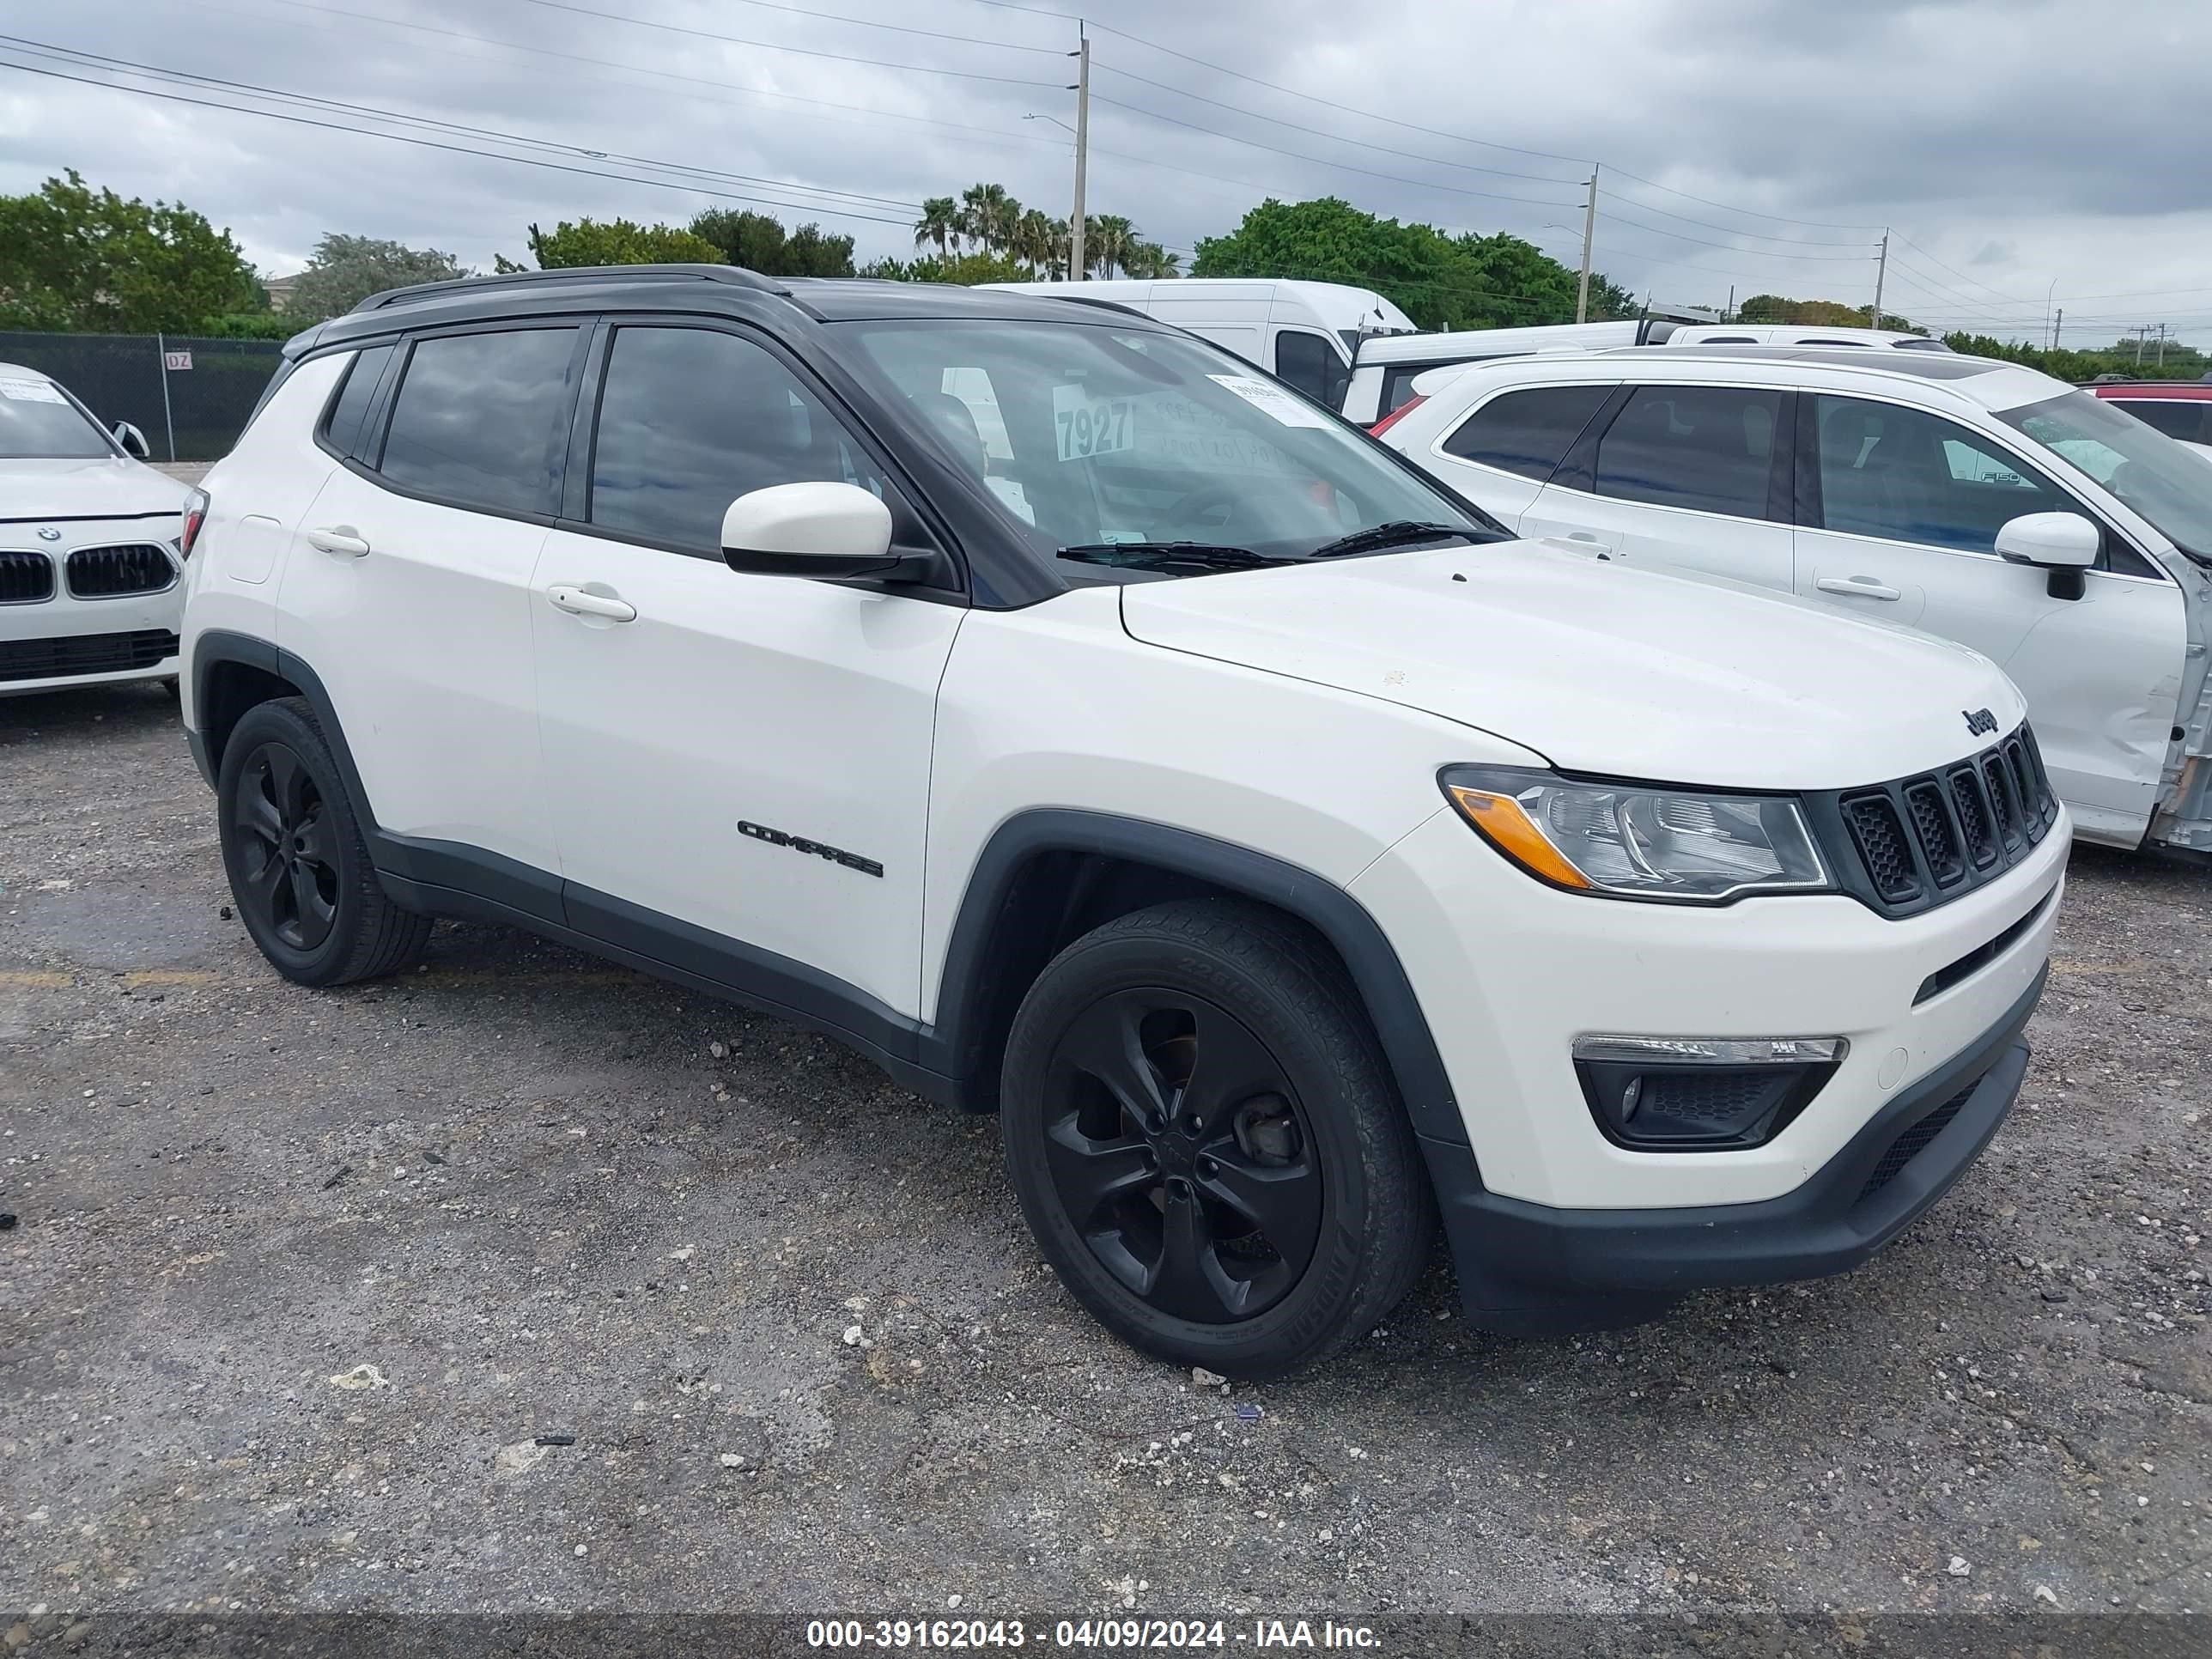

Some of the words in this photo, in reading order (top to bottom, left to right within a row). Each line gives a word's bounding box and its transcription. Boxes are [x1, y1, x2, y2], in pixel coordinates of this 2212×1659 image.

[168, 356, 189, 368] DZ
[1057, 402, 1128, 459] 7927
[1961, 708, 1999, 738] Jeep
[737, 819, 884, 878] COMPASS
